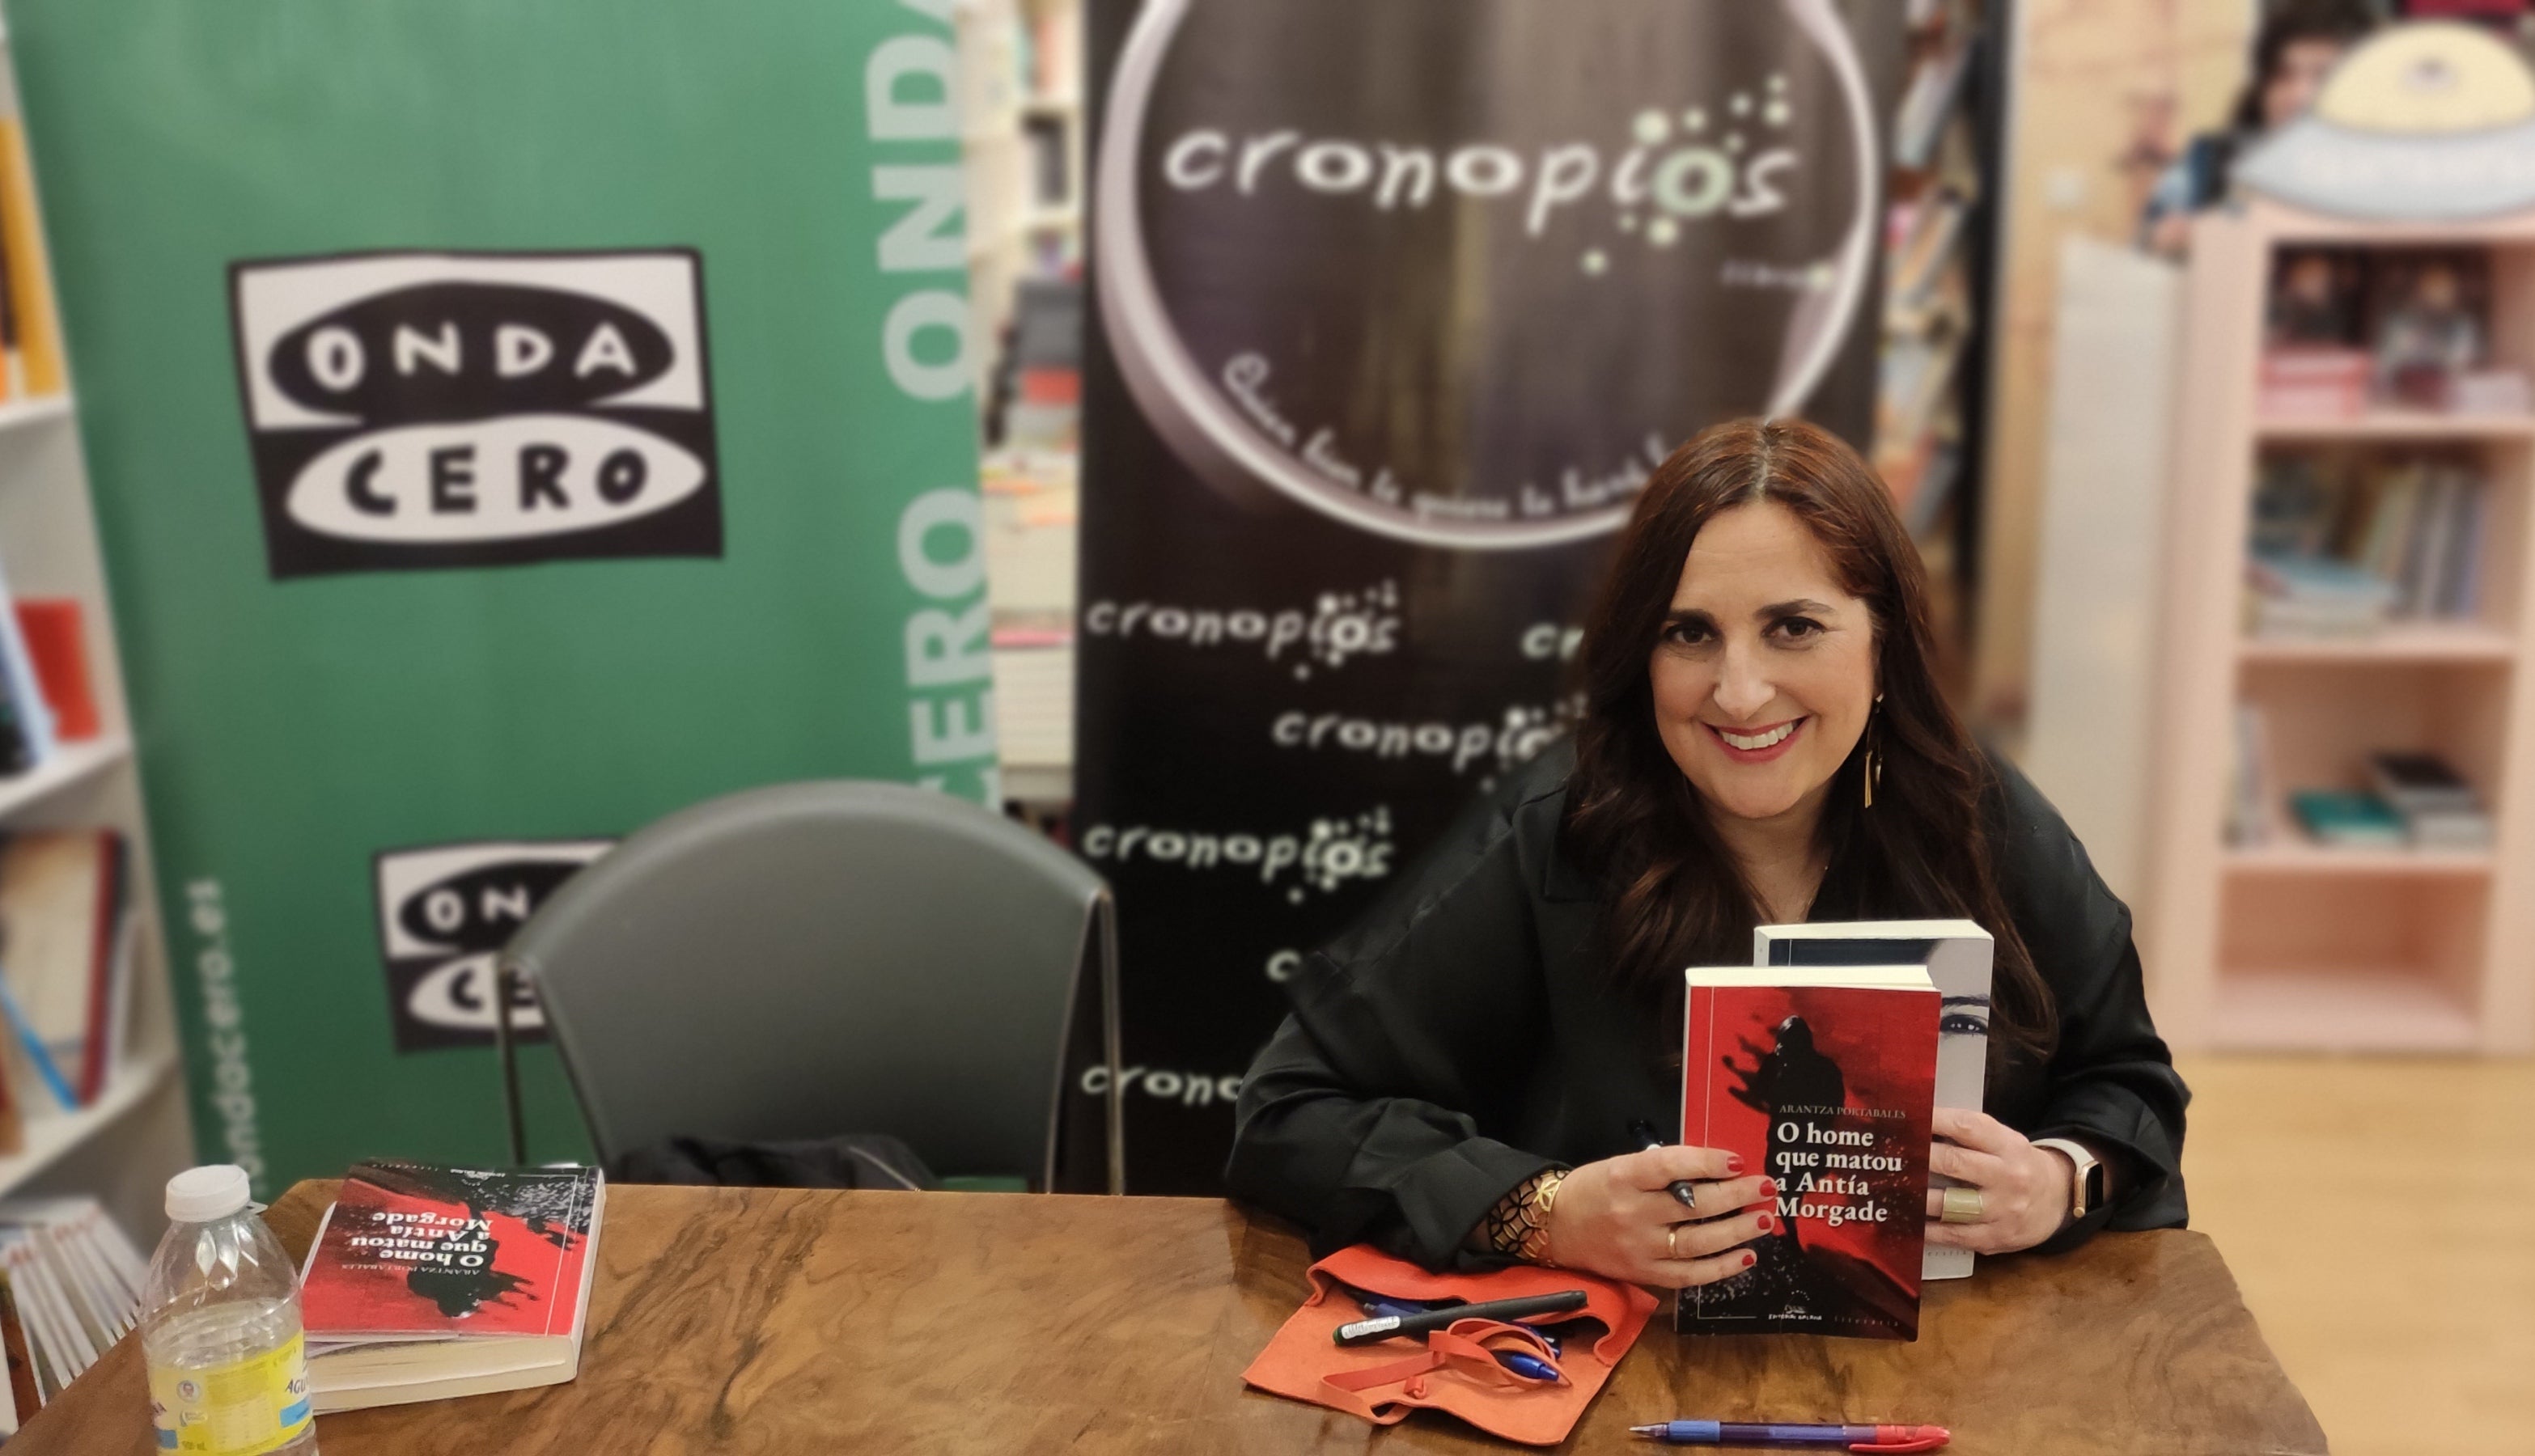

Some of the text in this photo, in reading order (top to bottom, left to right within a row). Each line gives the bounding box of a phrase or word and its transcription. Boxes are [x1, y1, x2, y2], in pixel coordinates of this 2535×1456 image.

[1165, 107, 1796, 238] cronopios
[863, 0, 975, 400] OND
[304, 320, 638, 392] ONDA
[343, 442, 650, 518] CERO
[1086, 589, 1401, 662] cronopios
[1083, 817, 1393, 883] cronopios
[424, 881, 528, 933] ON
[1779, 1104, 1906, 1120] ARANTZA PORTABALES
[1776, 1121, 1875, 1147] O home
[1775, 1150, 1903, 1174] que matou
[1776, 1171, 1870, 1196] a Antía
[371, 1212, 494, 1231] Morgade
[1774, 1196, 1889, 1227] Morgade
[350, 1235, 488, 1254] que matou
[389, 1224, 491, 1242] a Antía
[378, 1248, 484, 1267] O home
[285, 1378, 307, 1394] AGU
